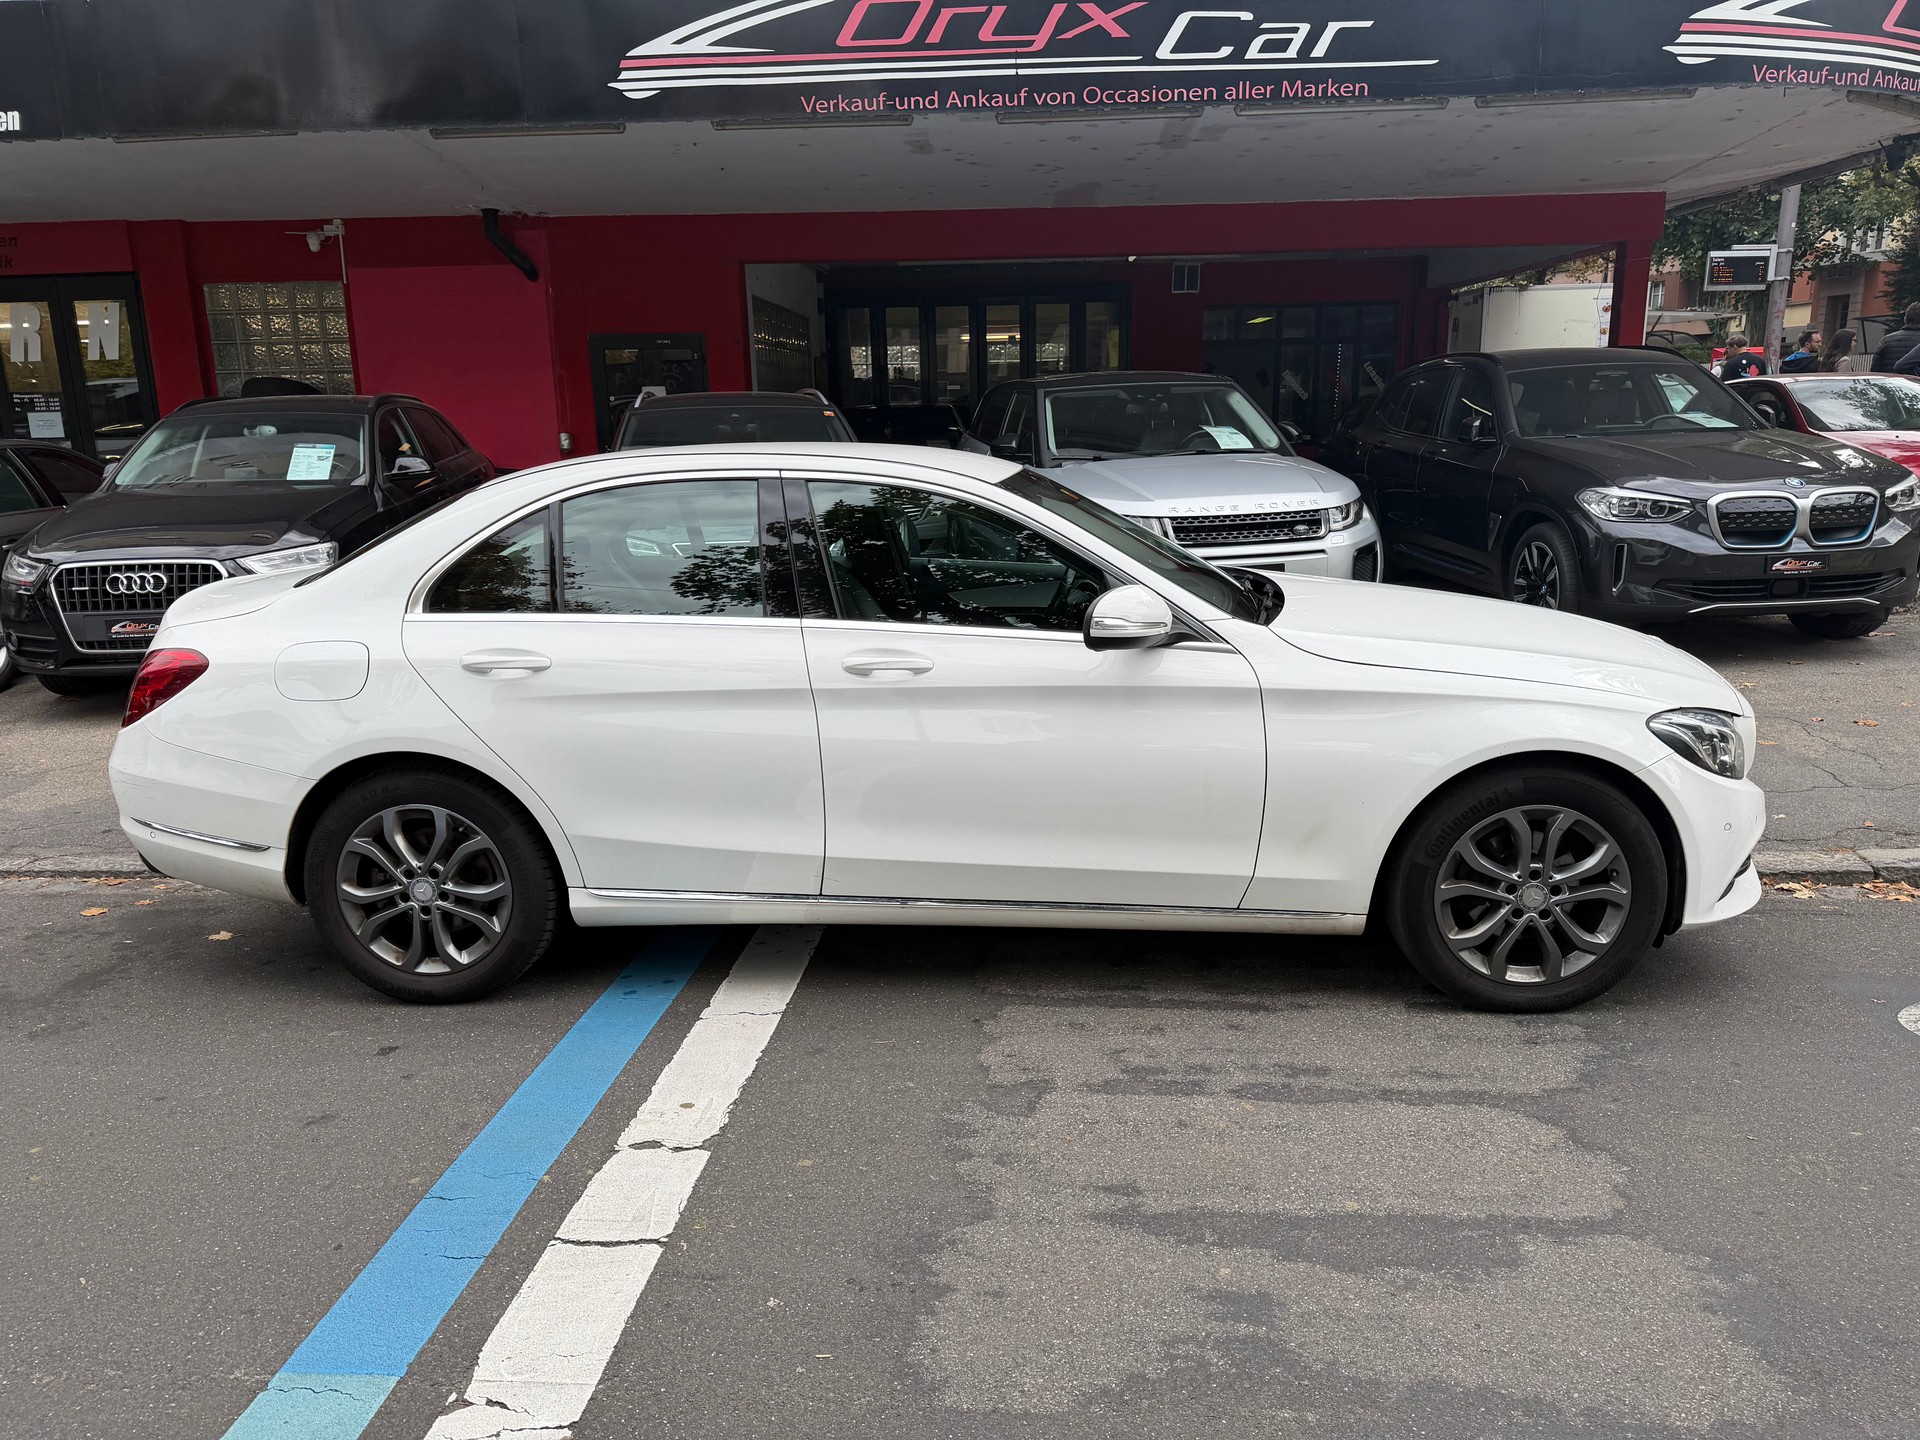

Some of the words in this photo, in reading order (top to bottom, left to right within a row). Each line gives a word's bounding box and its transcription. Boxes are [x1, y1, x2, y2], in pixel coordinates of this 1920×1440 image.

[835, 0, 1149, 52] Oryx
[1155, 10, 1375, 60] Car
[946, 87, 1029, 109] Ankauf
[1035, 91, 1076, 106] von
[1082, 86, 1217, 104] Occasionen
[1225, 81, 1274, 101] aller
[1281, 78, 1369, 98] Marken
[1363, 361, 1385, 391] Leasin
[1168, 504, 1240, 514] RANGE
[1254, 499, 1320, 510] ROVER
[1425, 790, 1501, 859] Continental
